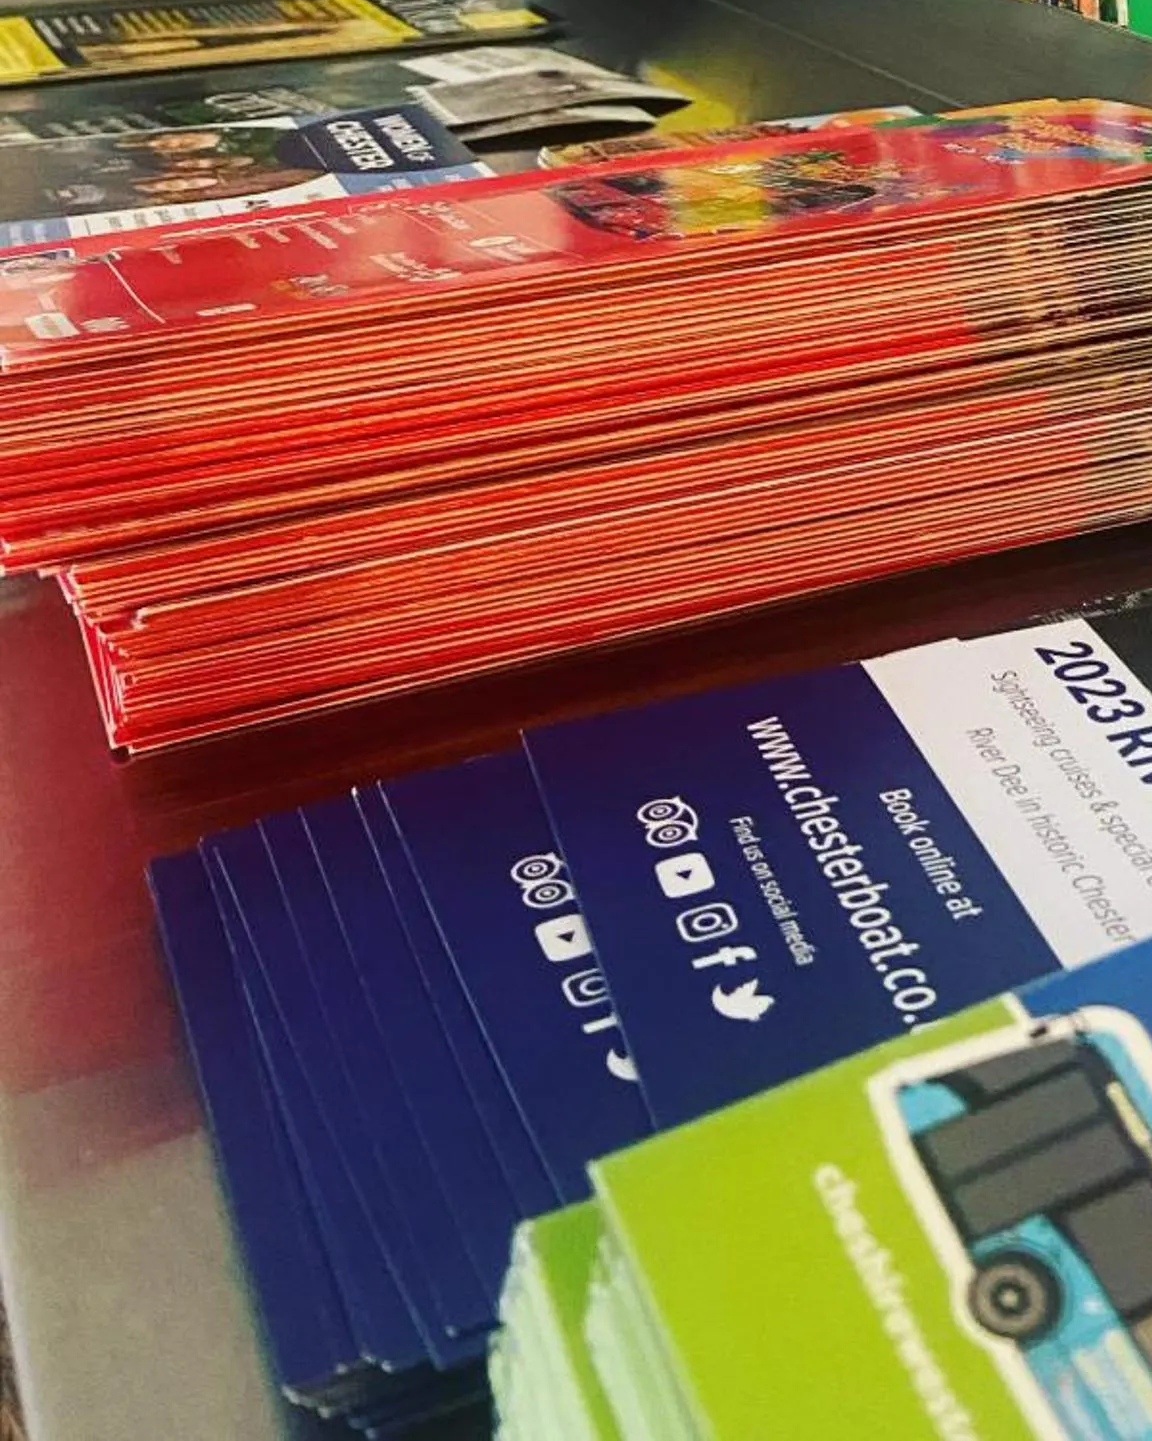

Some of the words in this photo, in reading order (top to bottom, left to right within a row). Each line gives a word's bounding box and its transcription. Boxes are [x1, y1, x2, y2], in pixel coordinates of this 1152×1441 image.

[326, 120, 395, 171] CHESTER
[1033, 640, 1146, 725] 2023
[966, 727, 1008, 768] River
[991, 670, 1063, 750] Sightseeing
[1048, 744, 1103, 802] cruises
[1091, 799, 1116, 817] &
[992, 765, 1028, 800] Dee
[729, 816, 762, 847] Find
[1015, 800, 1042, 817] in
[742, 846, 765, 864] us
[879, 787, 929, 837] Book
[910, 836, 962, 901] online
[945, 894, 983, 920] at
[1026, 813, 1086, 875] historic
[751, 863, 773, 881] on
[760, 877, 800, 921] social
[1072, 873, 1136, 944] Chester
[779, 917, 815, 966] media
